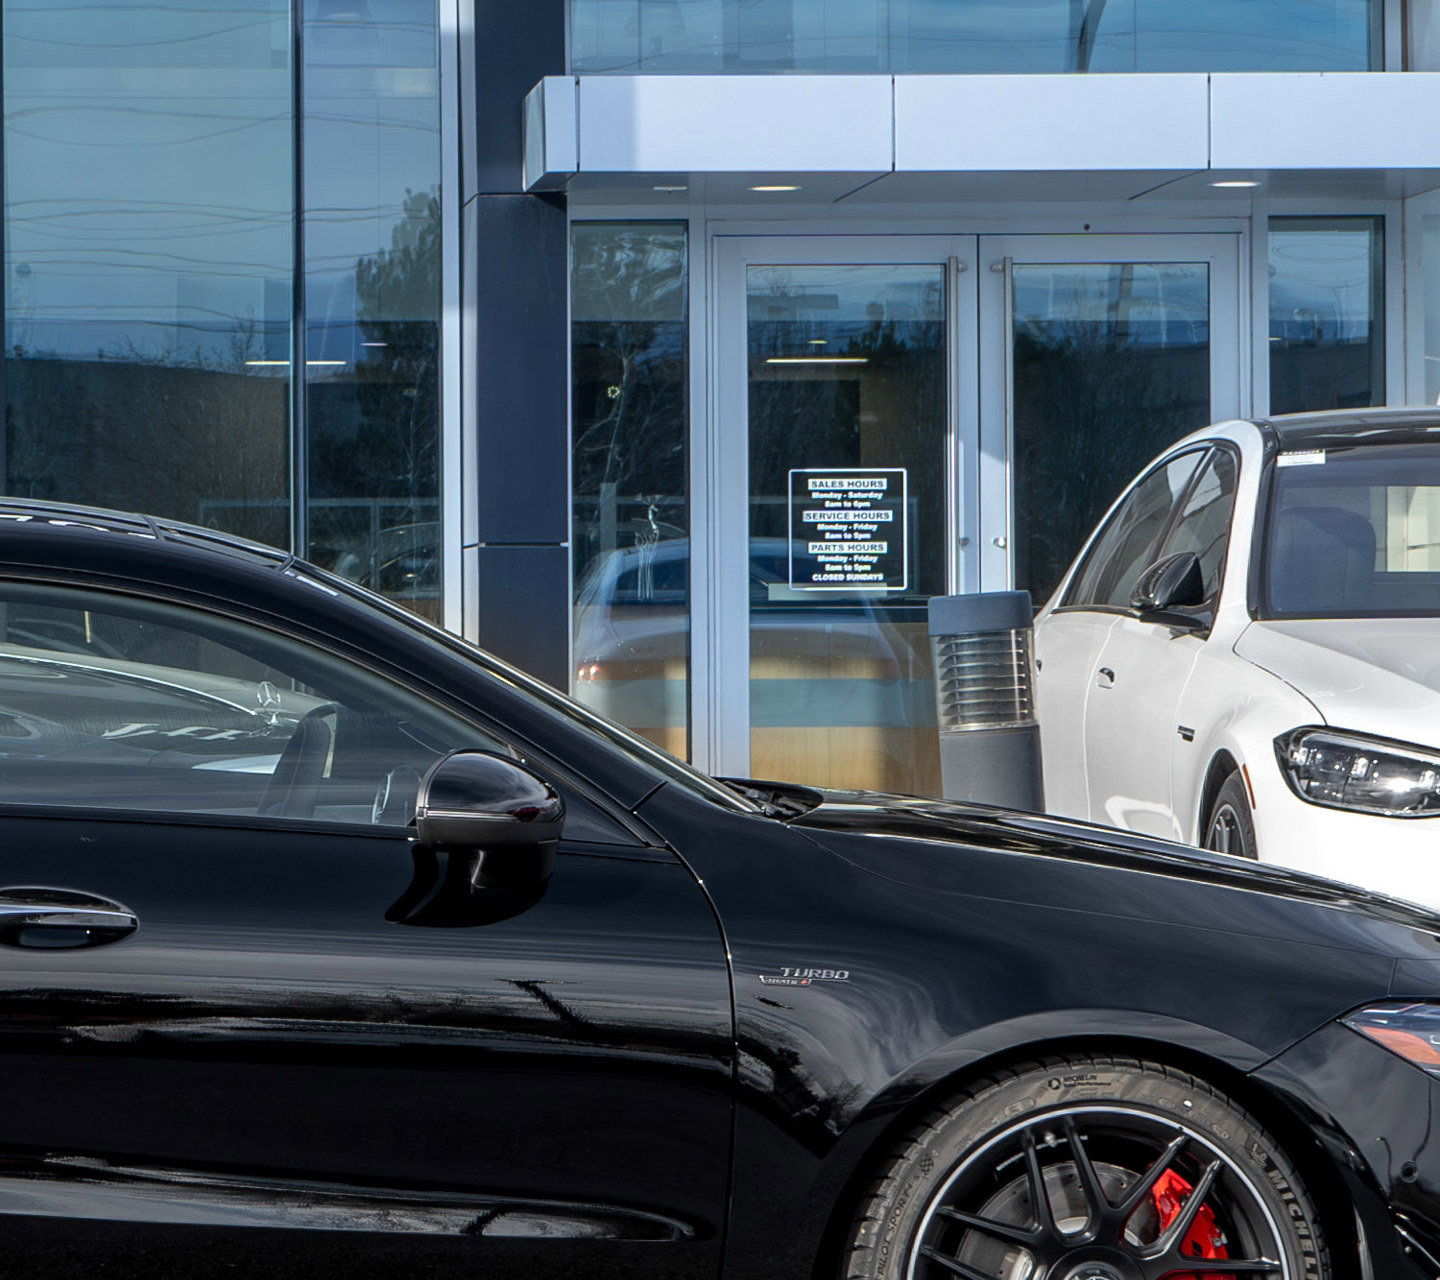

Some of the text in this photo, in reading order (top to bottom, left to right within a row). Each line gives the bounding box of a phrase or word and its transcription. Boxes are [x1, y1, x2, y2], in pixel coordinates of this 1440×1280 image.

[811, 480, 884, 488] SALES HOURS
[811, 491, 842, 500] Monday
[848, 491, 883, 500] Saturday
[843, 500, 852, 508] to
[805, 512, 890, 520] SERVICE HOURS
[817, 523, 848, 532] Monday
[853, 523, 878, 532] Friday
[811, 543, 884, 551] PARTS HOURS
[817, 555, 848, 563] Monday
[853, 555, 878, 563] Friday
[812, 573, 884, 581] CLOSED SUNDAYS
[780, 967, 850, 980] TURBO
[878, 1236, 892, 1277] PILOT
